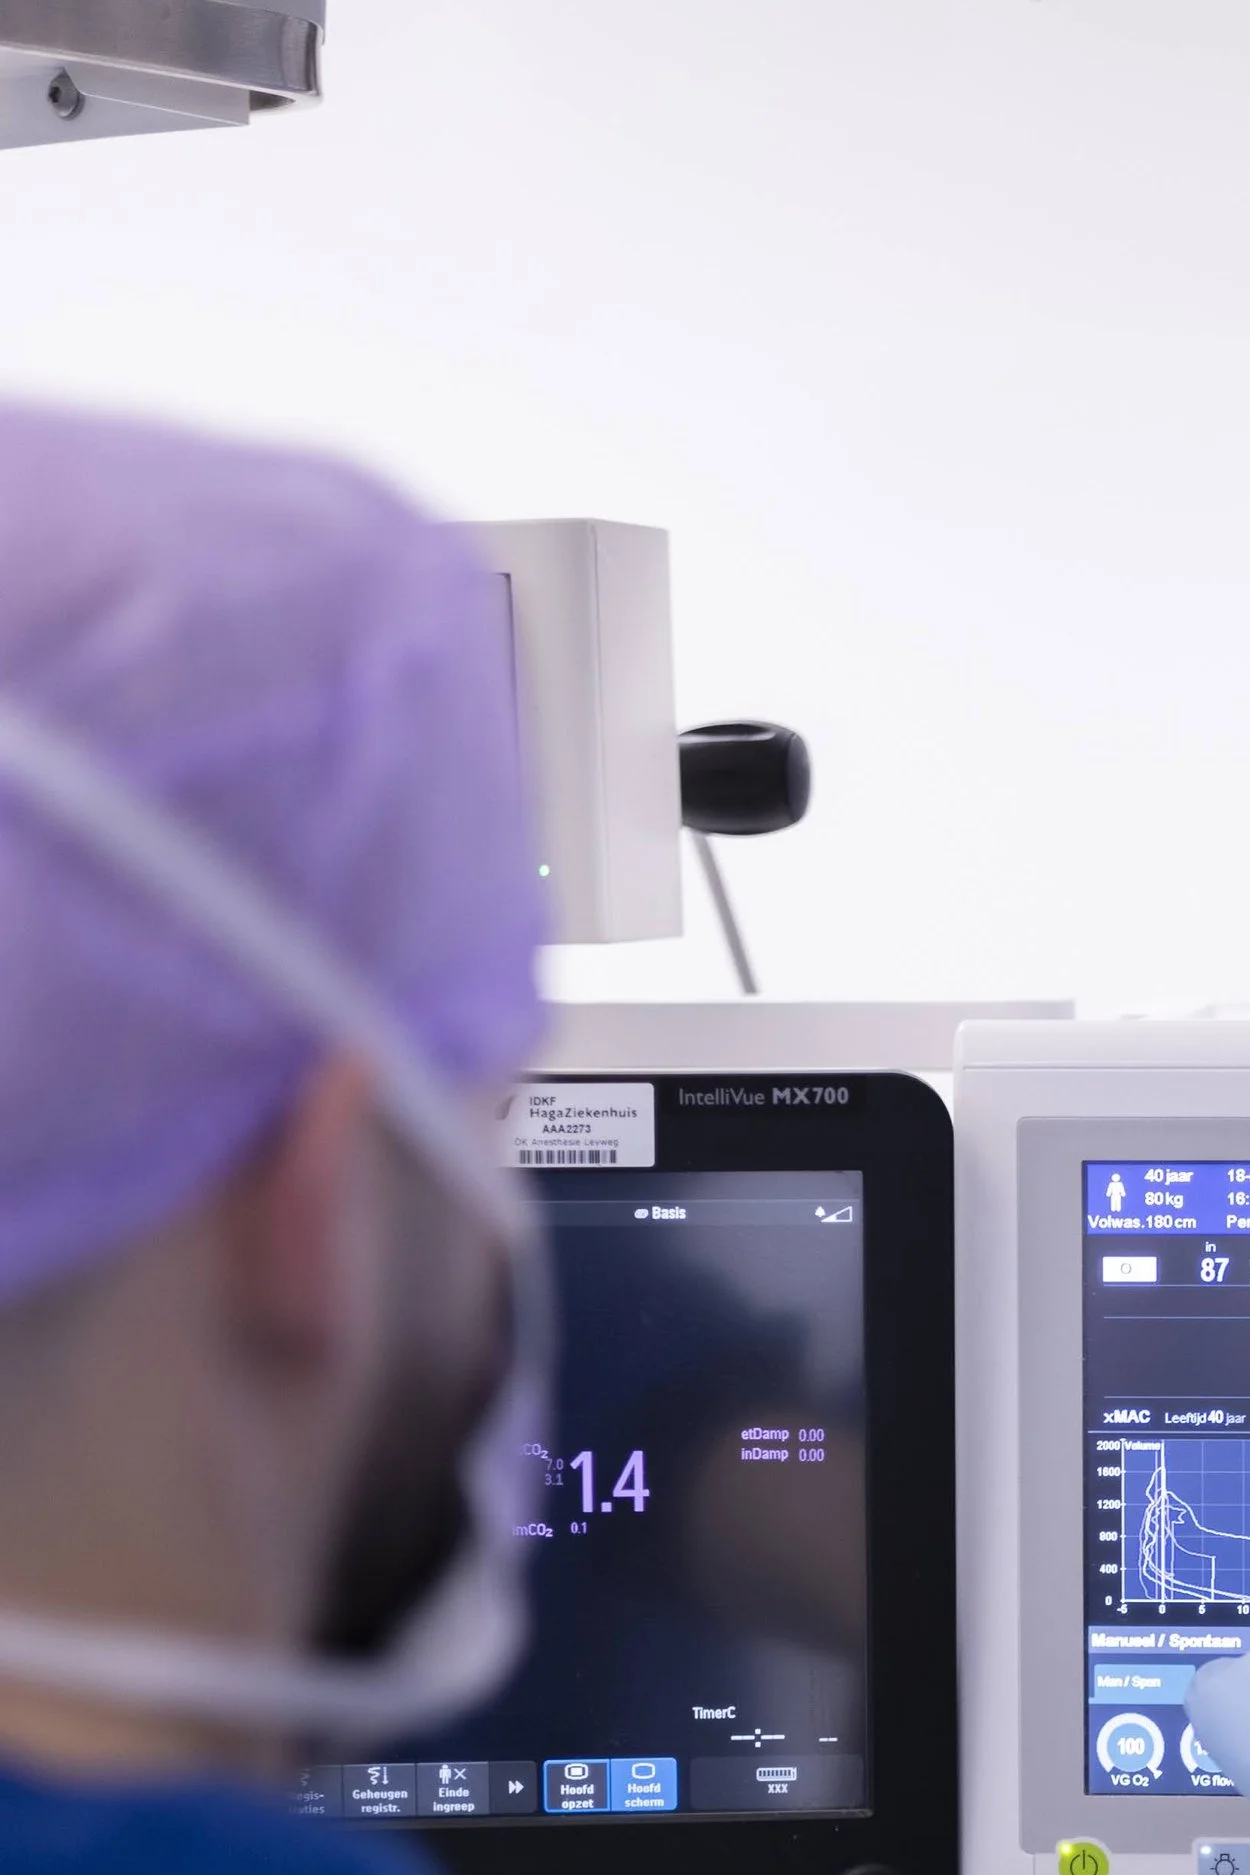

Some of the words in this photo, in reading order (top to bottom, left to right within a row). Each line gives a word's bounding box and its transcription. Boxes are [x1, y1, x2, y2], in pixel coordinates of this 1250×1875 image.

[529, 1096, 557, 1106] IDKF
[679, 1088, 765, 1106] IntelliVue
[772, 1086, 849, 1105] MX700
[529, 1107, 638, 1121] HagaZiekenhuis
[542, 1124, 592, 1134] AAA2273
[1144, 1169, 1163, 1182] 40
[1165, 1169, 1194, 1185] jaar
[1144, 1192, 1163, 1205] 80
[1165, 1192, 1184, 1208] kg
[652, 1206, 686, 1220] Basis
[1087, 1215, 1145, 1229] Volwas.
[1146, 1215, 1172, 1229] 180
[1174, 1218, 1197, 1229] cm
[1205, 1241, 1217, 1252] in
[1200, 1257, 1230, 1282] 87
[1103, 1410, 1151, 1423] xMAC
[1164, 1412, 1206, 1425] Leeftijd
[1207, 1409, 1224, 1423] 40
[1225, 1412, 1246, 1426] jaar
[741, 1428, 790, 1441] etDamp
[799, 1428, 825, 1442] 0.00
[519, 1443, 548, 1459] CO2
[1097, 1441, 1121, 1451] 2000
[741, 1448, 789, 1461] inDamp
[799, 1448, 825, 1462] 0.00
[1097, 1467, 1121, 1477] 1600
[570, 1450, 650, 1513] 1.4
[1097, 1500, 1121, 1510] 1200
[1099, 1532, 1118, 1542] 800
[1099, 1564, 1118, 1574] 400
[692, 1706, 736, 1719] TimerC
[1117, 1738, 1146, 1755] 100
[1111, 1774, 1130, 1786] VG
[1191, 1774, 1210, 1786] VG
[439, 1787, 470, 1798] Einde
[560, 1784, 594, 1795] Hoofd
[627, 1783, 661, 1793] Hoofd
[352, 1789, 408, 1801] Geheugen
[361, 1803, 401, 1814] registr.
[433, 1801, 475, 1813] ingreep
[561, 1798, 594, 1810] opzet
[624, 1797, 664, 1808] scherm
